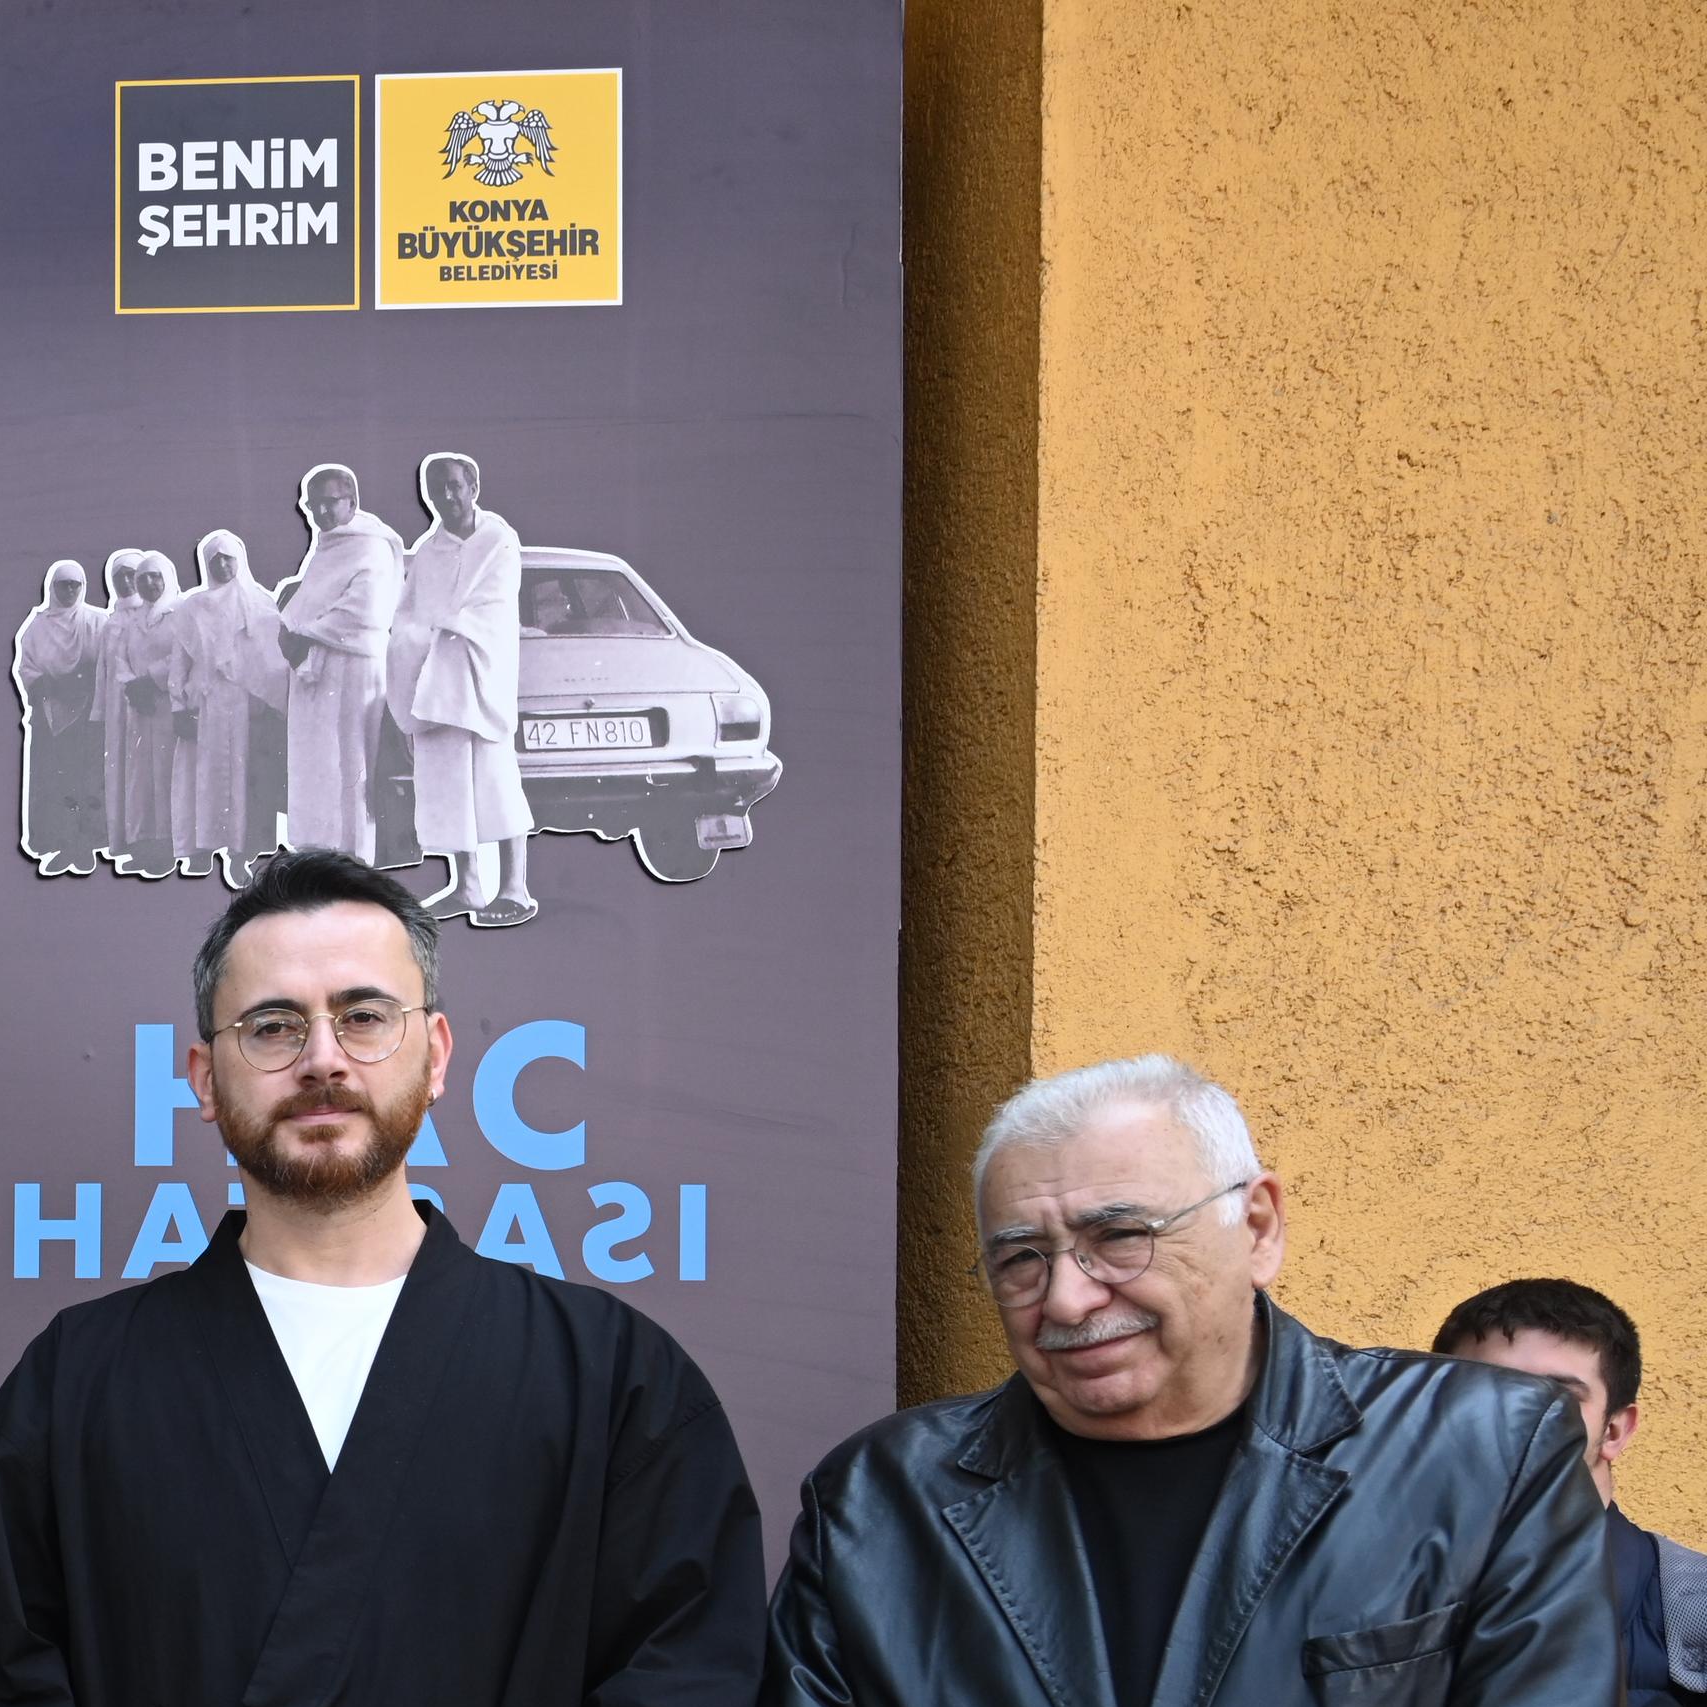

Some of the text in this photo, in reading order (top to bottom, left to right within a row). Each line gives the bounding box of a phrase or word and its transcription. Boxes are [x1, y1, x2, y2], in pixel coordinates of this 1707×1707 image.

[448, 198, 549, 224] KONYA
[397, 223, 600, 262] BÜYÜKŞEHİR
[439, 259, 559, 282] BELEDİYESİ
[528, 722, 558, 746] 42
